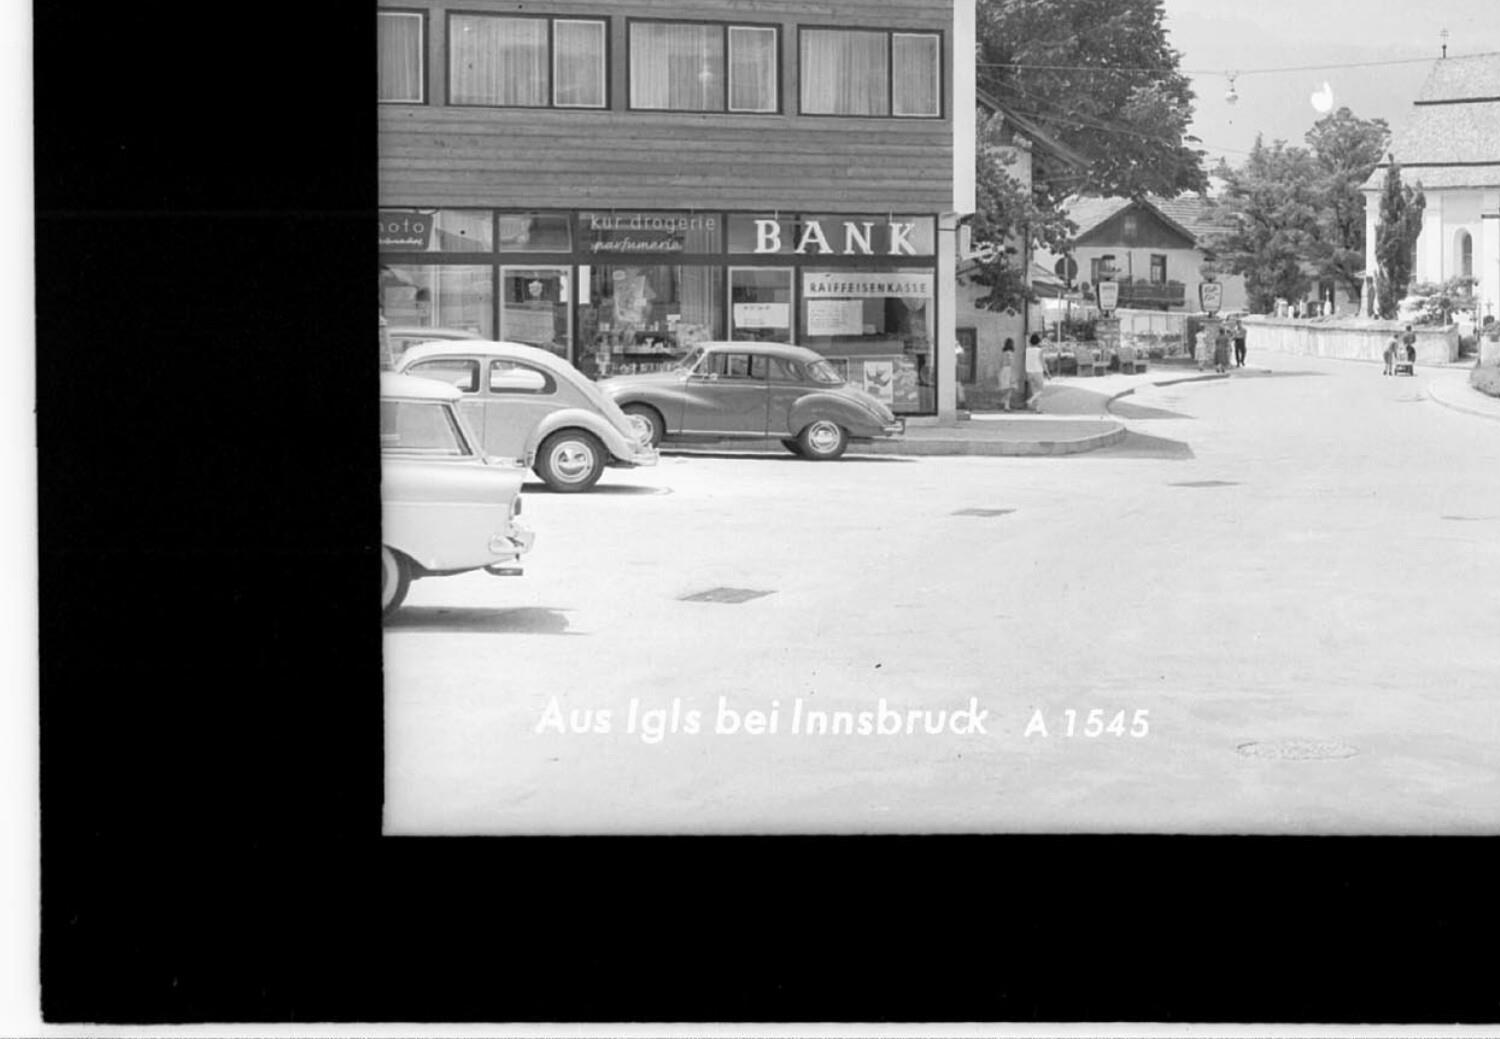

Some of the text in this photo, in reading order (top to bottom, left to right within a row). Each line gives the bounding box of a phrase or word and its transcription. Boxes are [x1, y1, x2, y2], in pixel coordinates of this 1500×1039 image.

[590, 213, 717, 234] kur drogerie
[753, 219, 918, 256] BANK
[809, 281, 928, 294] RAIFFEISENKASSE
